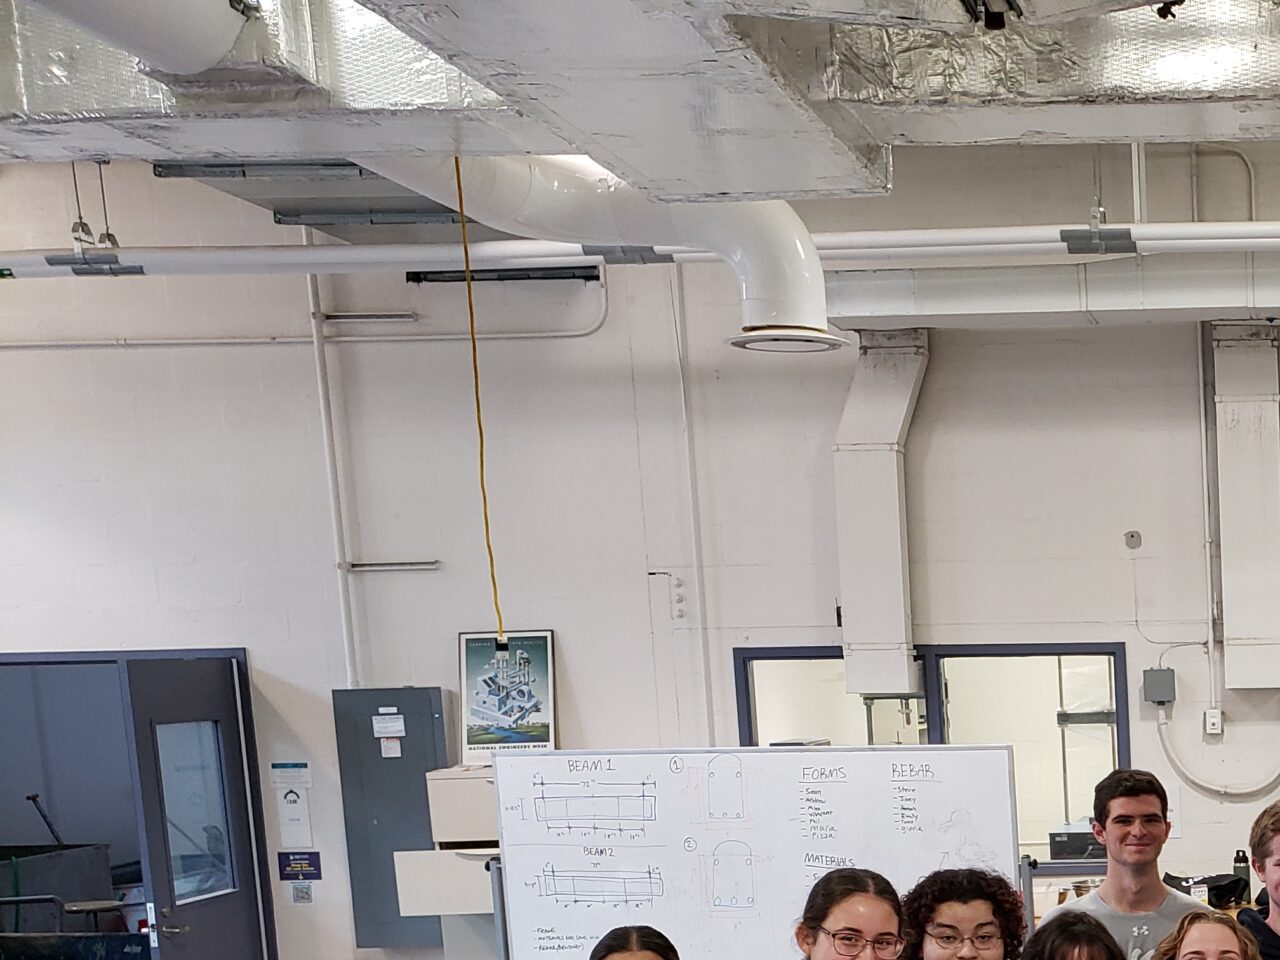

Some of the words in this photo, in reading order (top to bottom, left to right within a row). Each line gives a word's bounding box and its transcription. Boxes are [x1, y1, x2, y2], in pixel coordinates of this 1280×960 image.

[568, 759, 602, 773] BEAM
[802, 766, 847, 780] FORMS
[891, 763, 935, 779] REBAR
[583, 847, 607, 857] BEAM
[804, 852, 856, 867] MATERIALS
